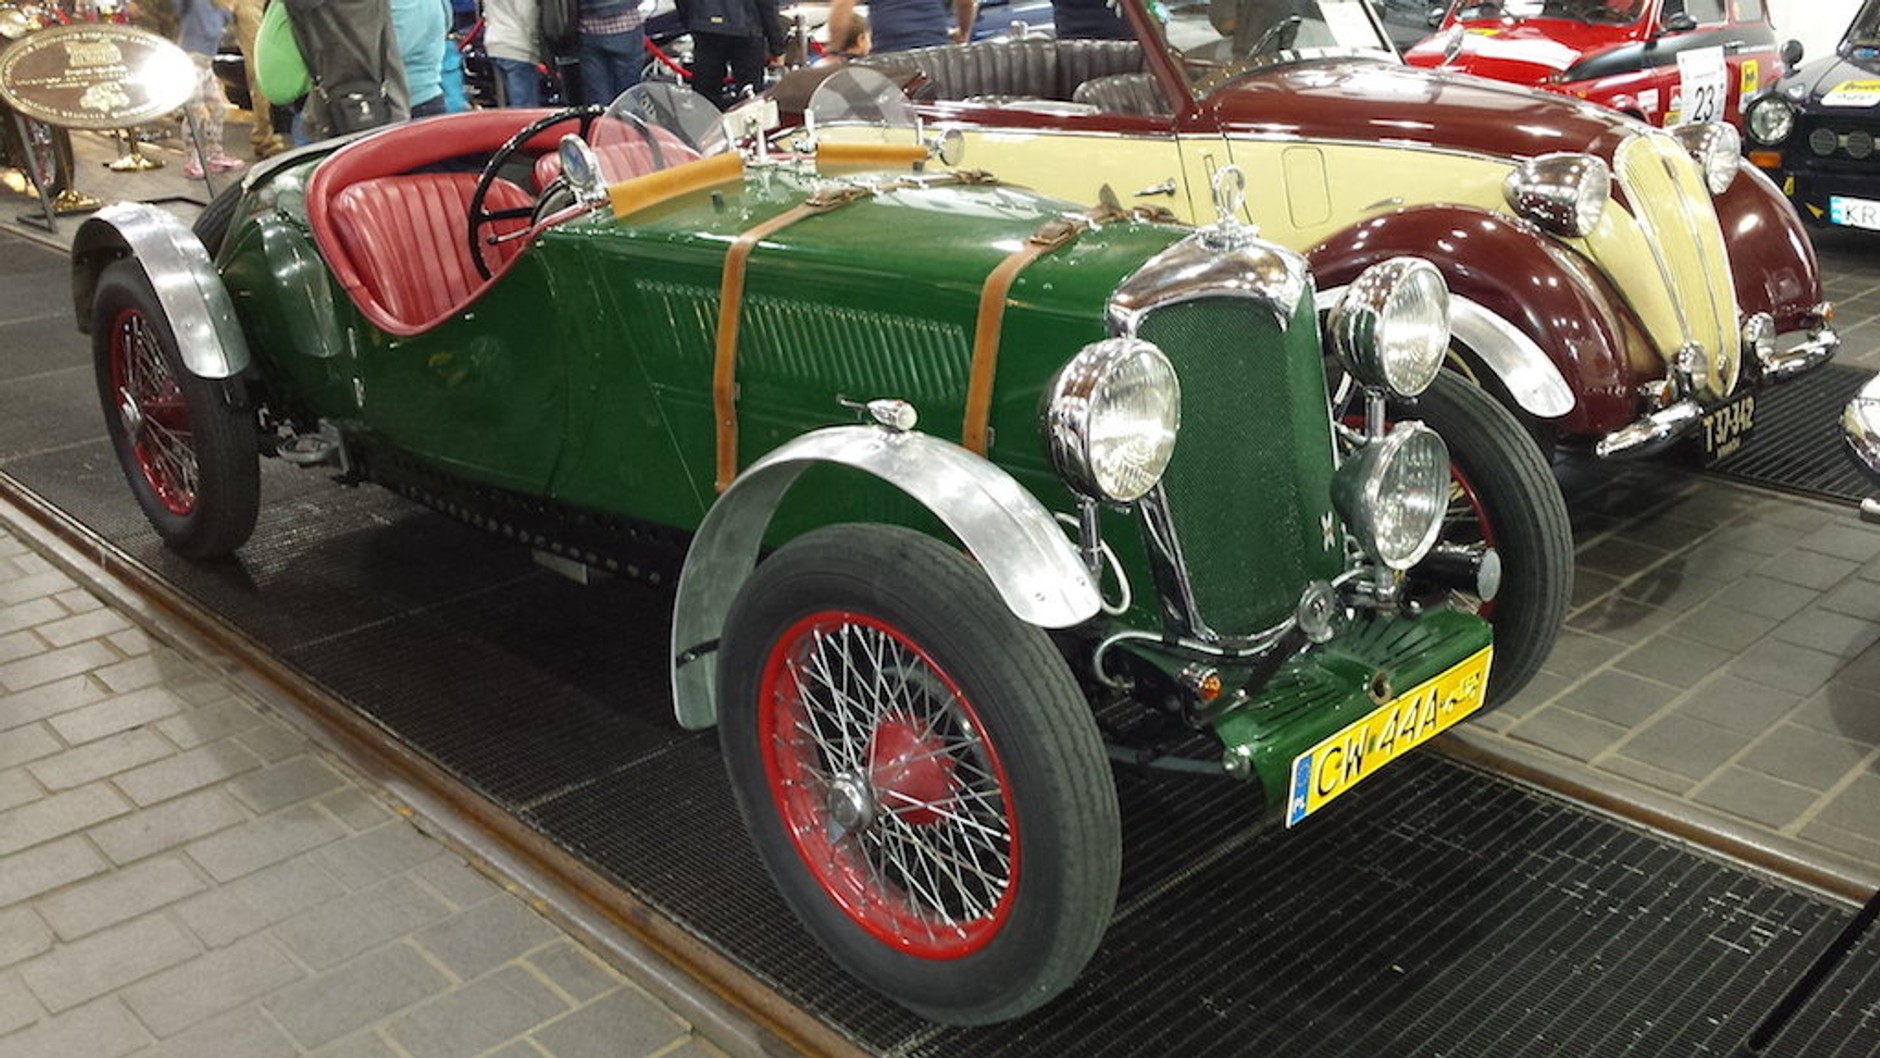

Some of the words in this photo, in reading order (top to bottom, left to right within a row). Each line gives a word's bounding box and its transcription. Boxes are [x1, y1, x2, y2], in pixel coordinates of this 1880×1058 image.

[1692, 84, 1716, 122] 23
[1317, 727, 1369, 796] CW
[1378, 688, 1438, 755] 44A
